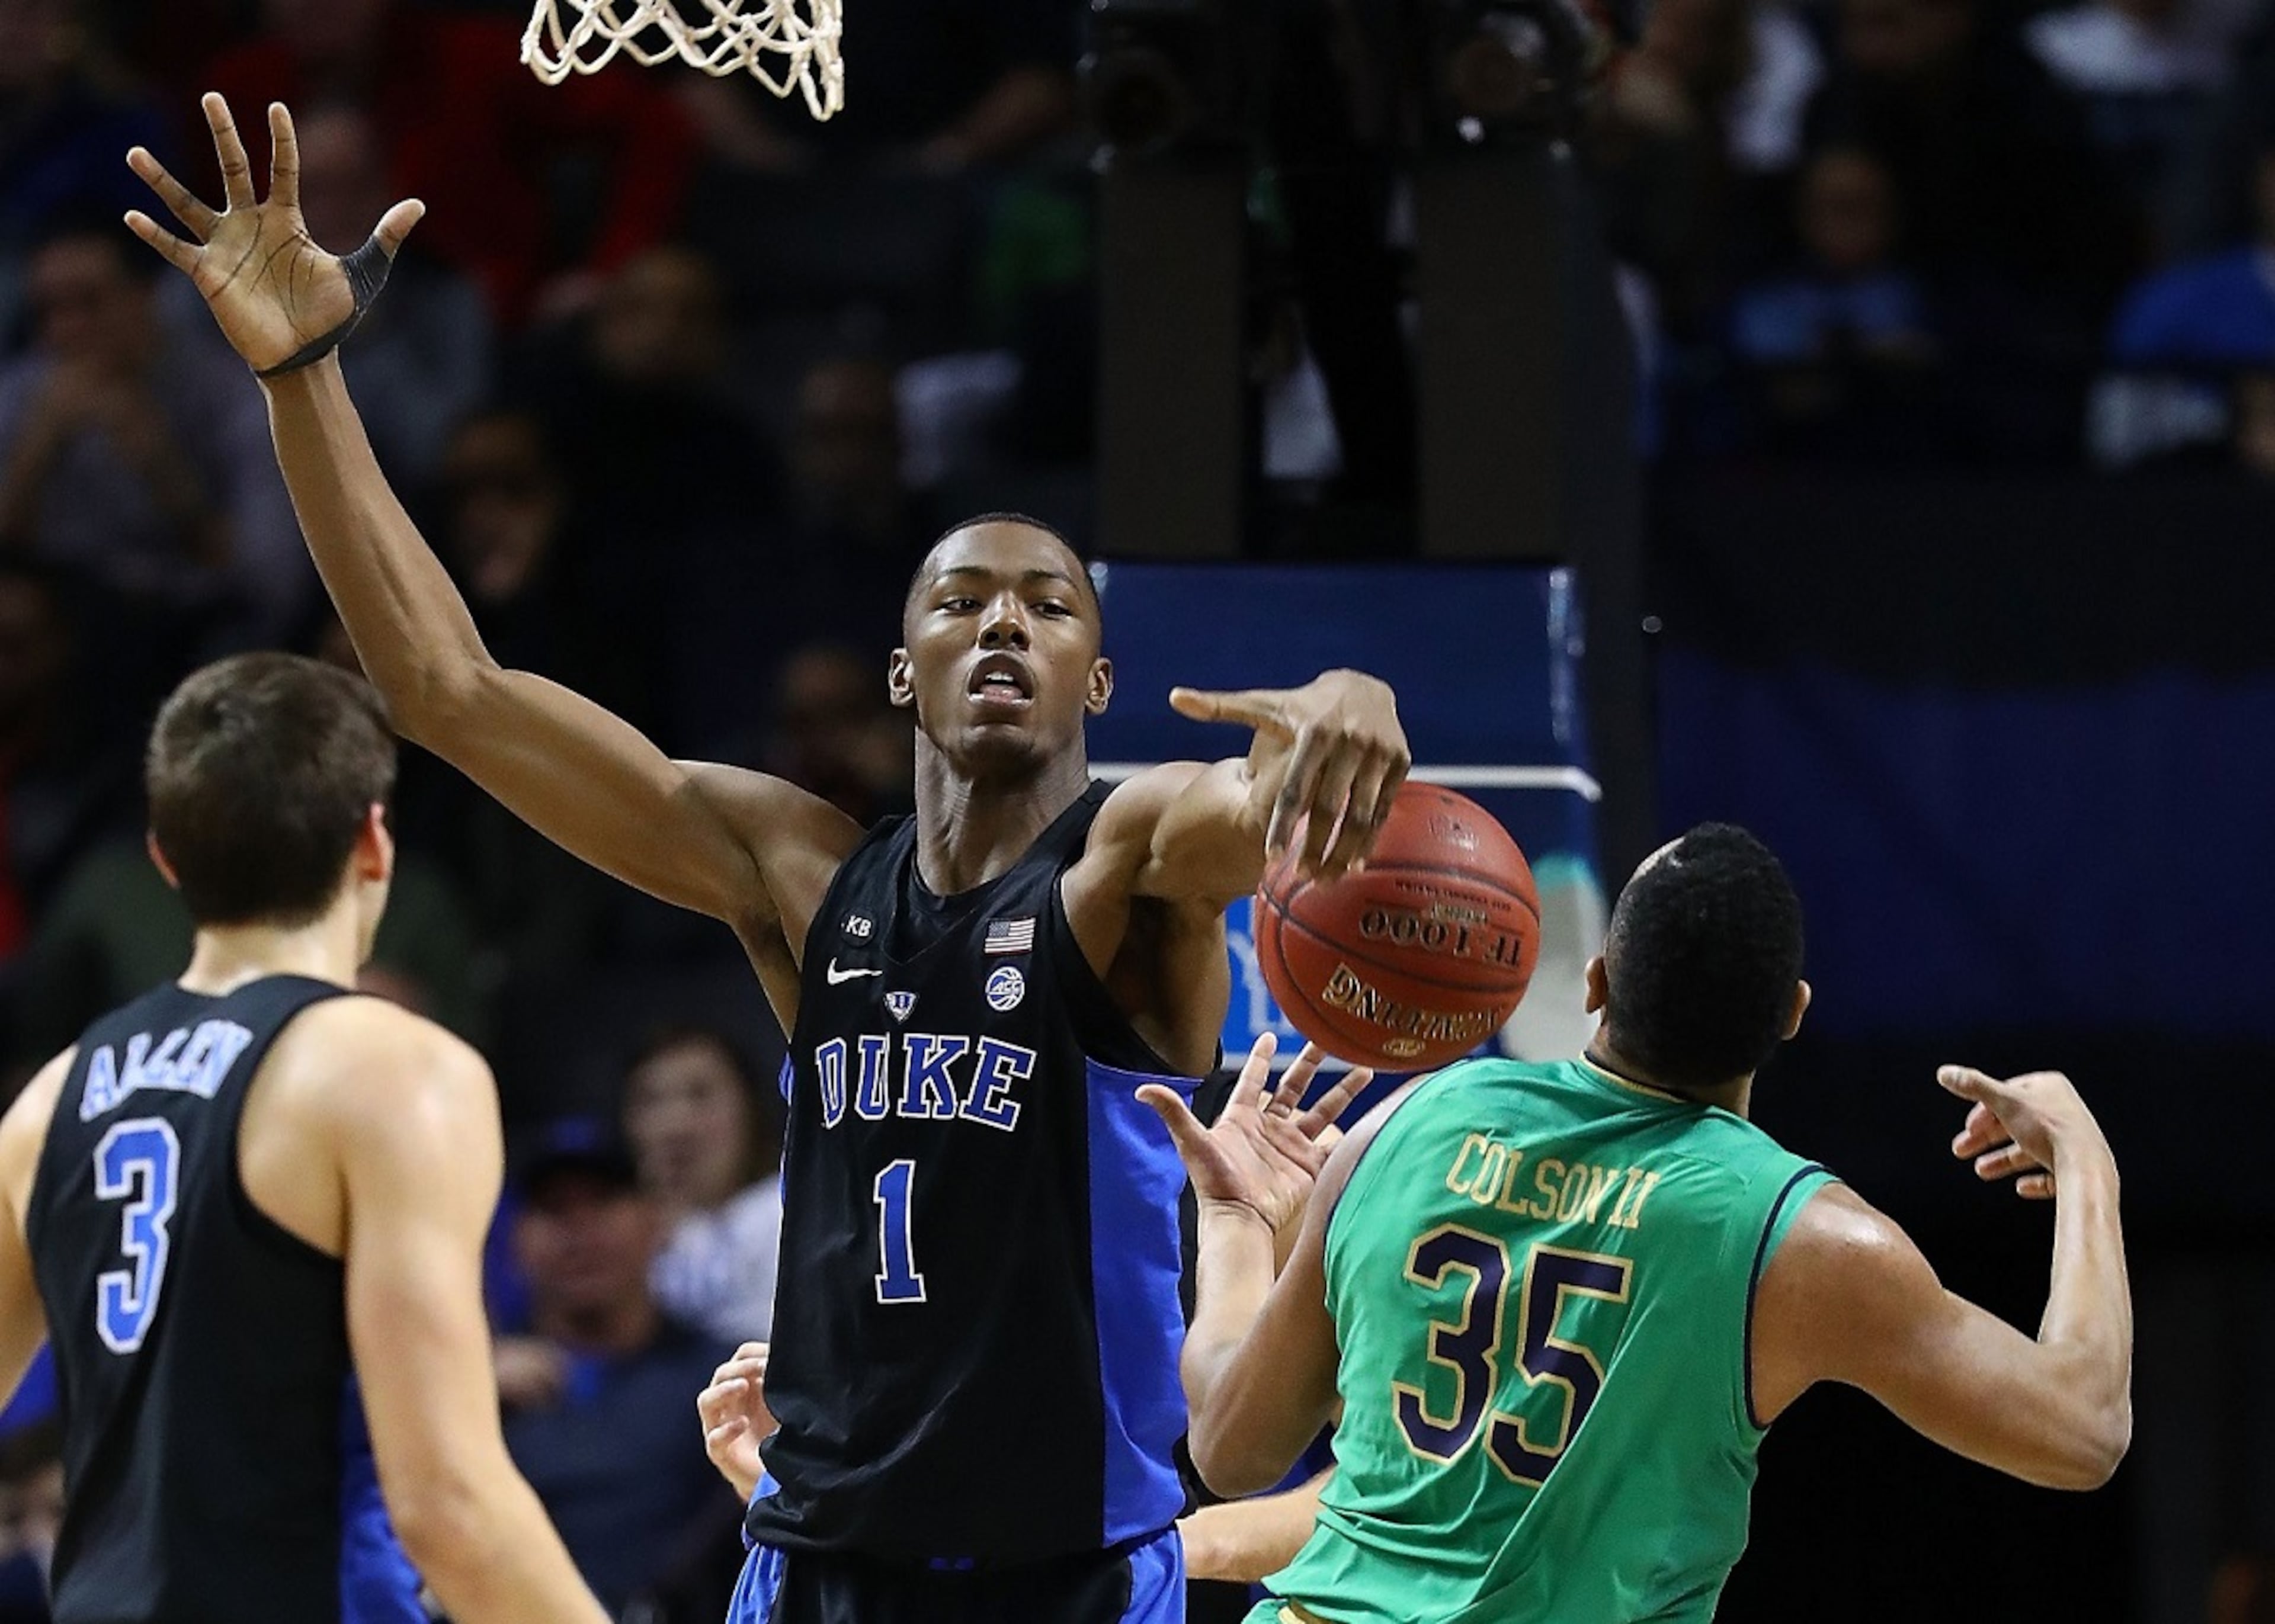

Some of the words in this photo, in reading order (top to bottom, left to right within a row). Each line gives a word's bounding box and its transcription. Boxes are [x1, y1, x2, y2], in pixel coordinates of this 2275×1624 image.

[845, 915, 872, 937] KB
[79, 1019, 254, 1122] ALLEN
[815, 1032, 1037, 1132] DUKE
[1446, 1132, 1619, 1224] COLSON
[93, 1116, 181, 1355] 3
[873, 1158, 927, 1303] 1
[1392, 1222, 1634, 1489] 35
